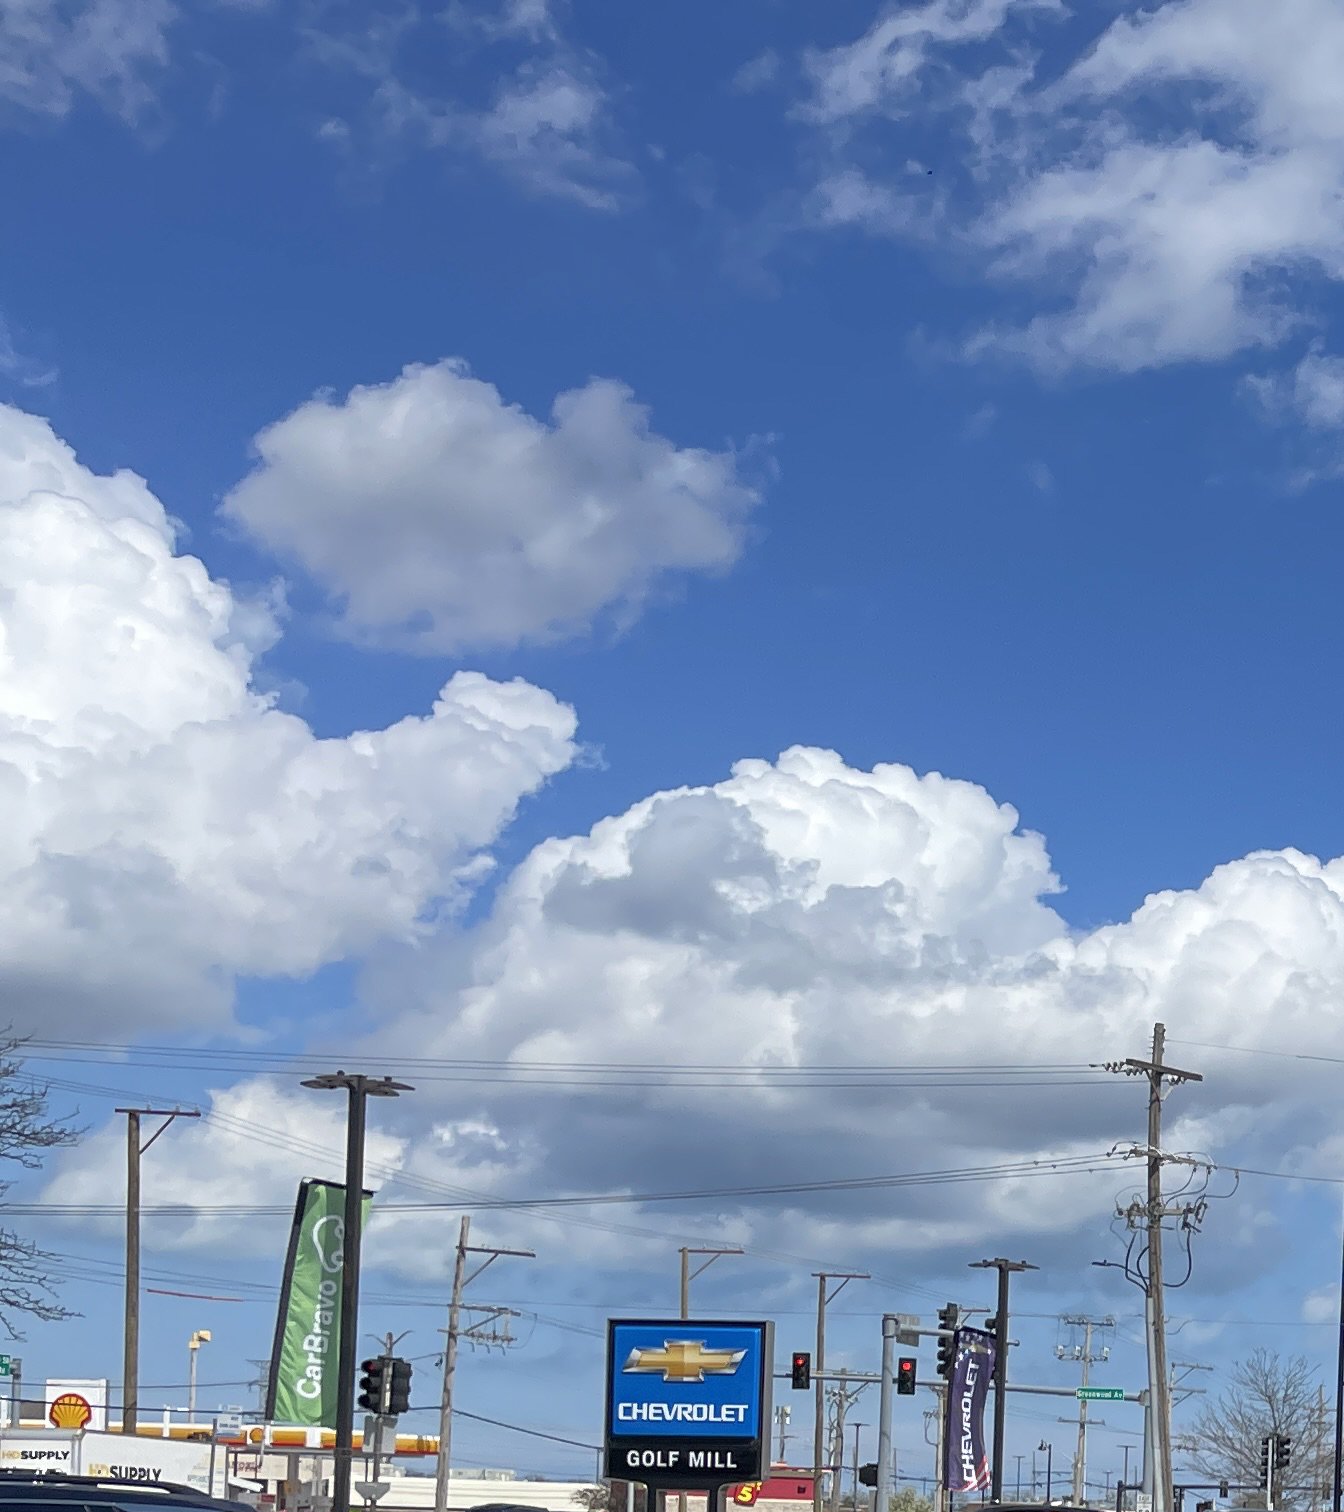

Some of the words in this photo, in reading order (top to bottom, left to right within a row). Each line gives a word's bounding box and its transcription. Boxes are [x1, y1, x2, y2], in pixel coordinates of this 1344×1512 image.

[296, 1279, 338, 1399] CarBravo
[618, 1402, 749, 1423] CHEVROLET
[961, 1359, 980, 1482] CHEVROLET
[626, 1450, 680, 1467] GOLF
[688, 1451, 738, 1468] MILL
